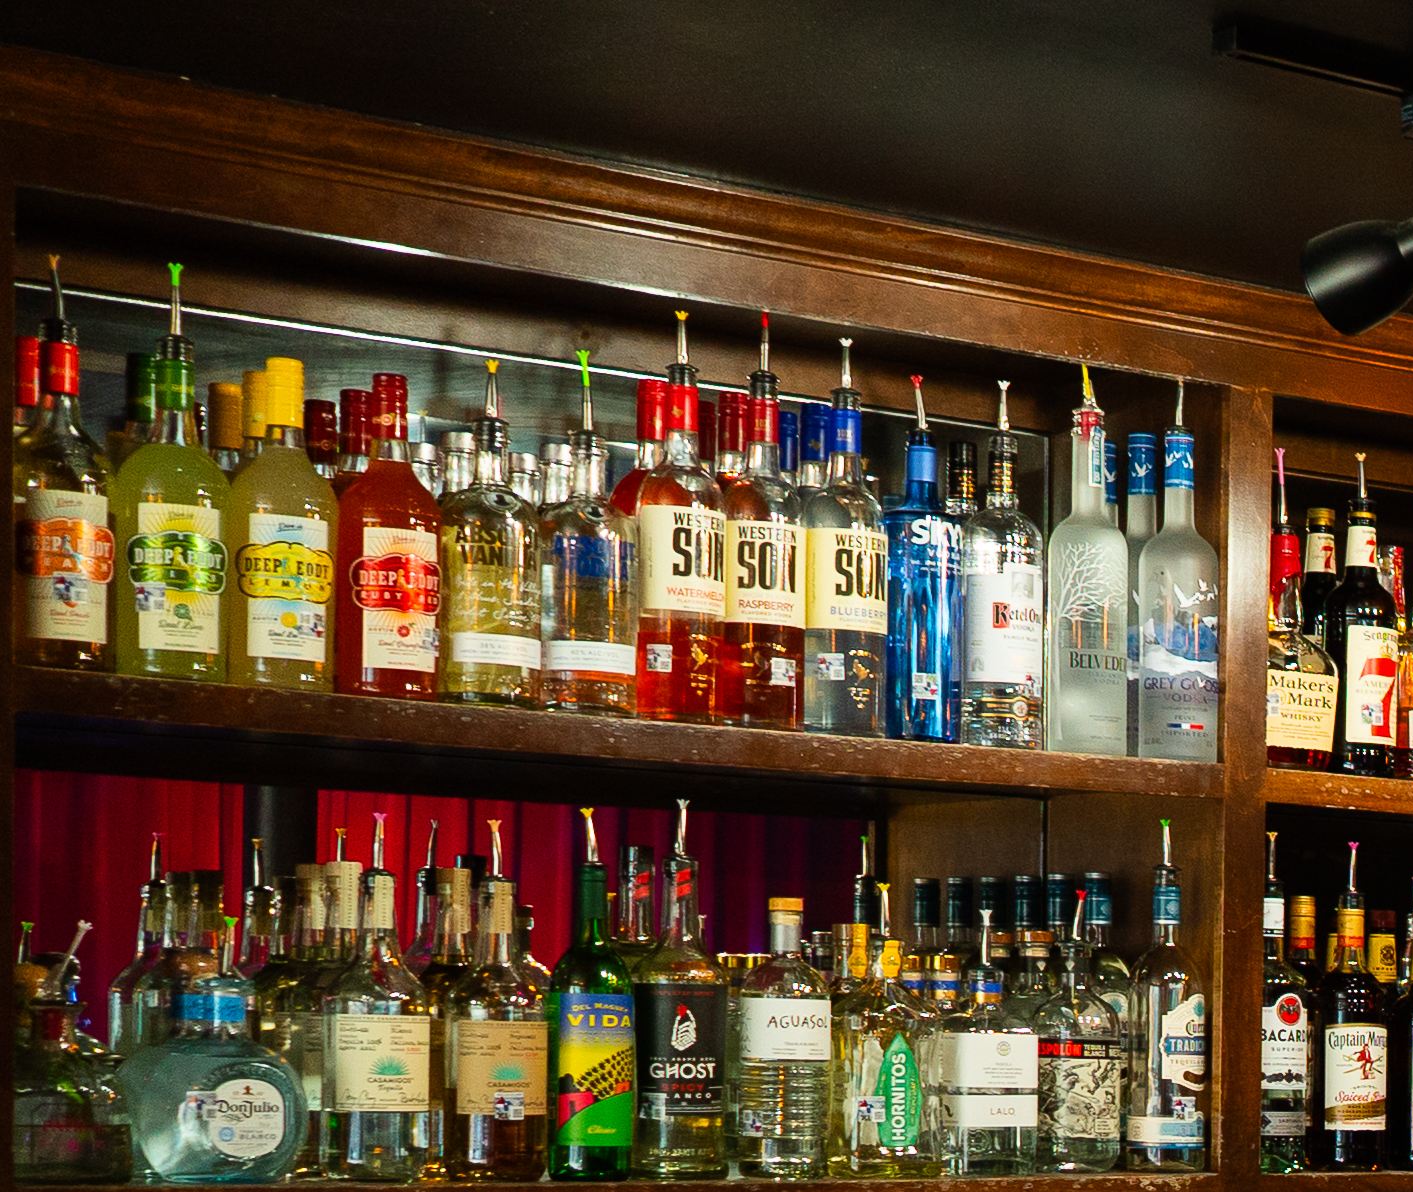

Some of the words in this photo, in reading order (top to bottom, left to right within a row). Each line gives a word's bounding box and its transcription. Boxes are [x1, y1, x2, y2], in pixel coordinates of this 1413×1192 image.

[30, 535, 61, 552] EEP
[738, 526, 796, 544] WESTERN
[134, 547, 173, 564] DEEP
[187, 551, 221, 570] EDDY
[672, 526, 724, 583] SON
[244, 557, 282, 574] DEEP
[296, 560, 330, 580] EDDY
[737, 540, 796, 593] SON
[834, 548, 886, 602] SON
[358, 569, 397, 586] DEEP
[410, 574, 440, 591] EDDY
[360, 590, 402, 600] RUBY
[666, 586, 724, 602] WATERMELO
[738, 598, 794, 612] RASPBERRY
[994, 602, 1027, 626] Ketel
[1143, 676, 1175, 690] GREY
[1269, 674, 1335, 694] Maker's
[1288, 691, 1333, 710] Mark
[1280, 711, 1323, 723] WHISKY
[567, 1014, 632, 1028] VIDA
[1328, 1030, 1366, 1050] Captain
[650, 1063, 717, 1079] GHOST
[660, 1083, 704, 1092] SPICY
[891, 1052, 906, 1141] HORNITOS
[1334, 1090, 1371, 1103] Spiced
[214, 1099, 247, 1113] Don
[242, 1100, 279, 1118] Julio
[989, 1107, 1016, 1116] LALO
